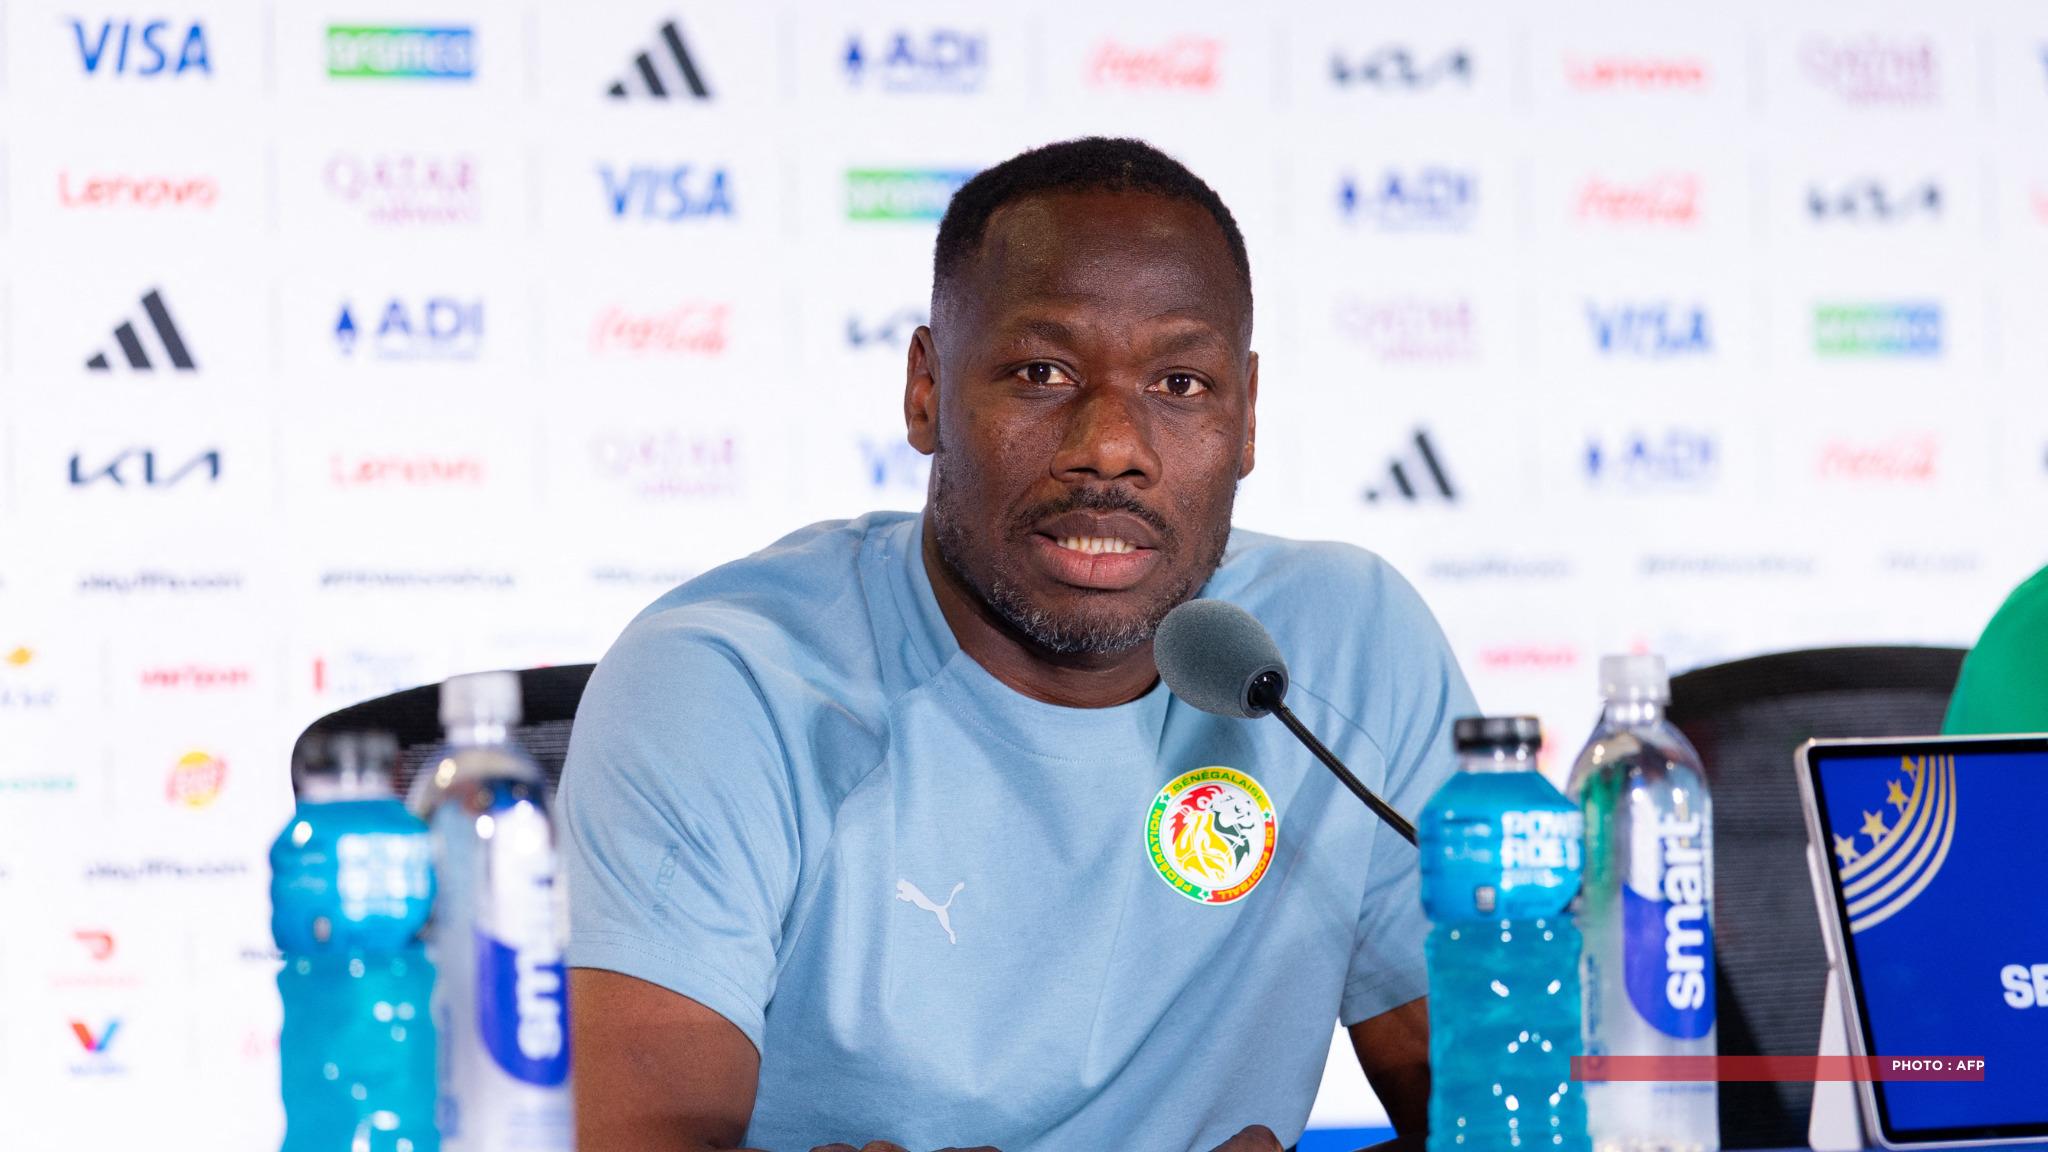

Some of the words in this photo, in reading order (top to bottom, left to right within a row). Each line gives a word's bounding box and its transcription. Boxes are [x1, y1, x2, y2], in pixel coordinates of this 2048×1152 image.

[71, 19, 212, 77] VISA
[598, 163, 736, 222] VISA
[375, 296, 484, 342] ADI
[67, 449, 222, 487] KIA
[1218, 851, 1271, 900] FOOTBALL
[1664, 811, 1706, 1011] smart
